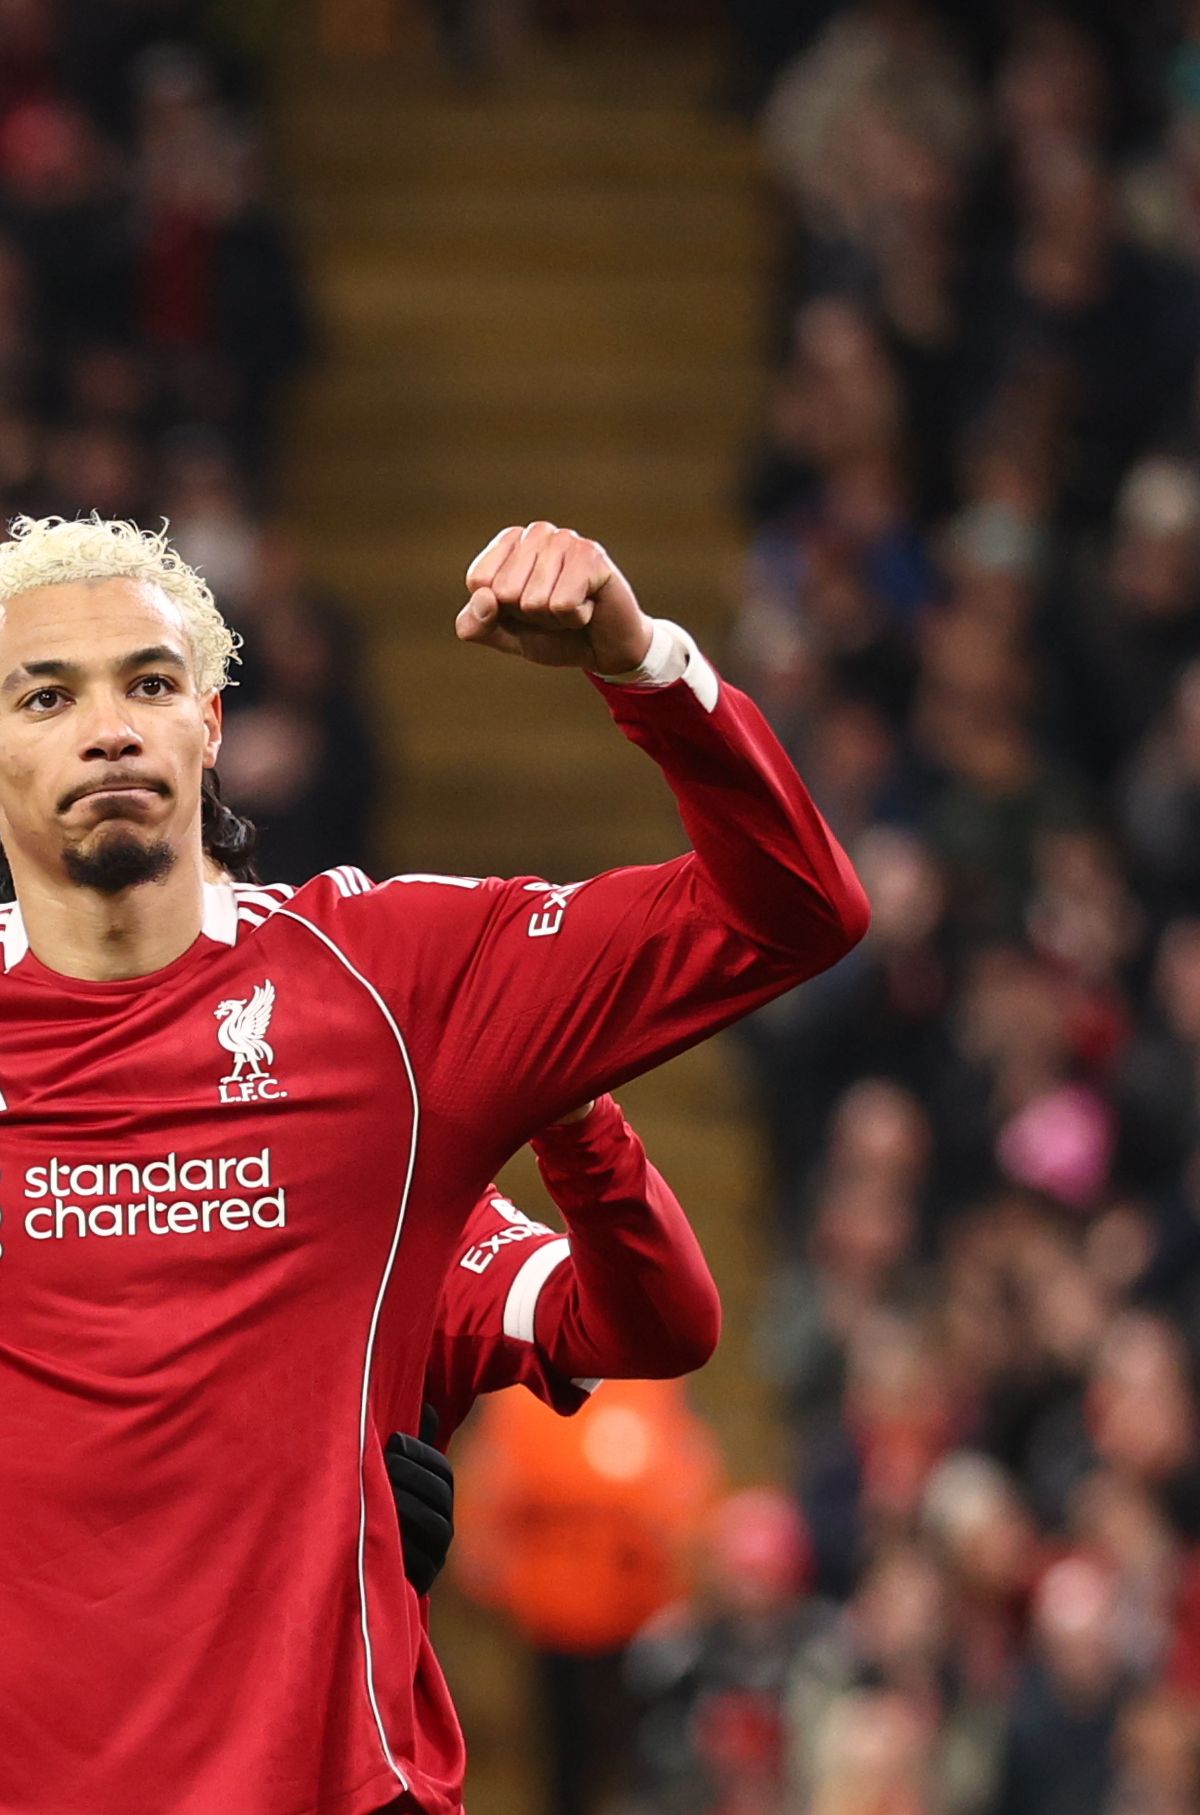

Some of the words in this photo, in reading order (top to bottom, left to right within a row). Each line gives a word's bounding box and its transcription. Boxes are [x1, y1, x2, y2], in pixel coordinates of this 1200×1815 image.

[218, 1077, 288, 1104] L.F.C.
[24, 1147, 270, 1199] standard
[24, 1187, 286, 1240] chartered
